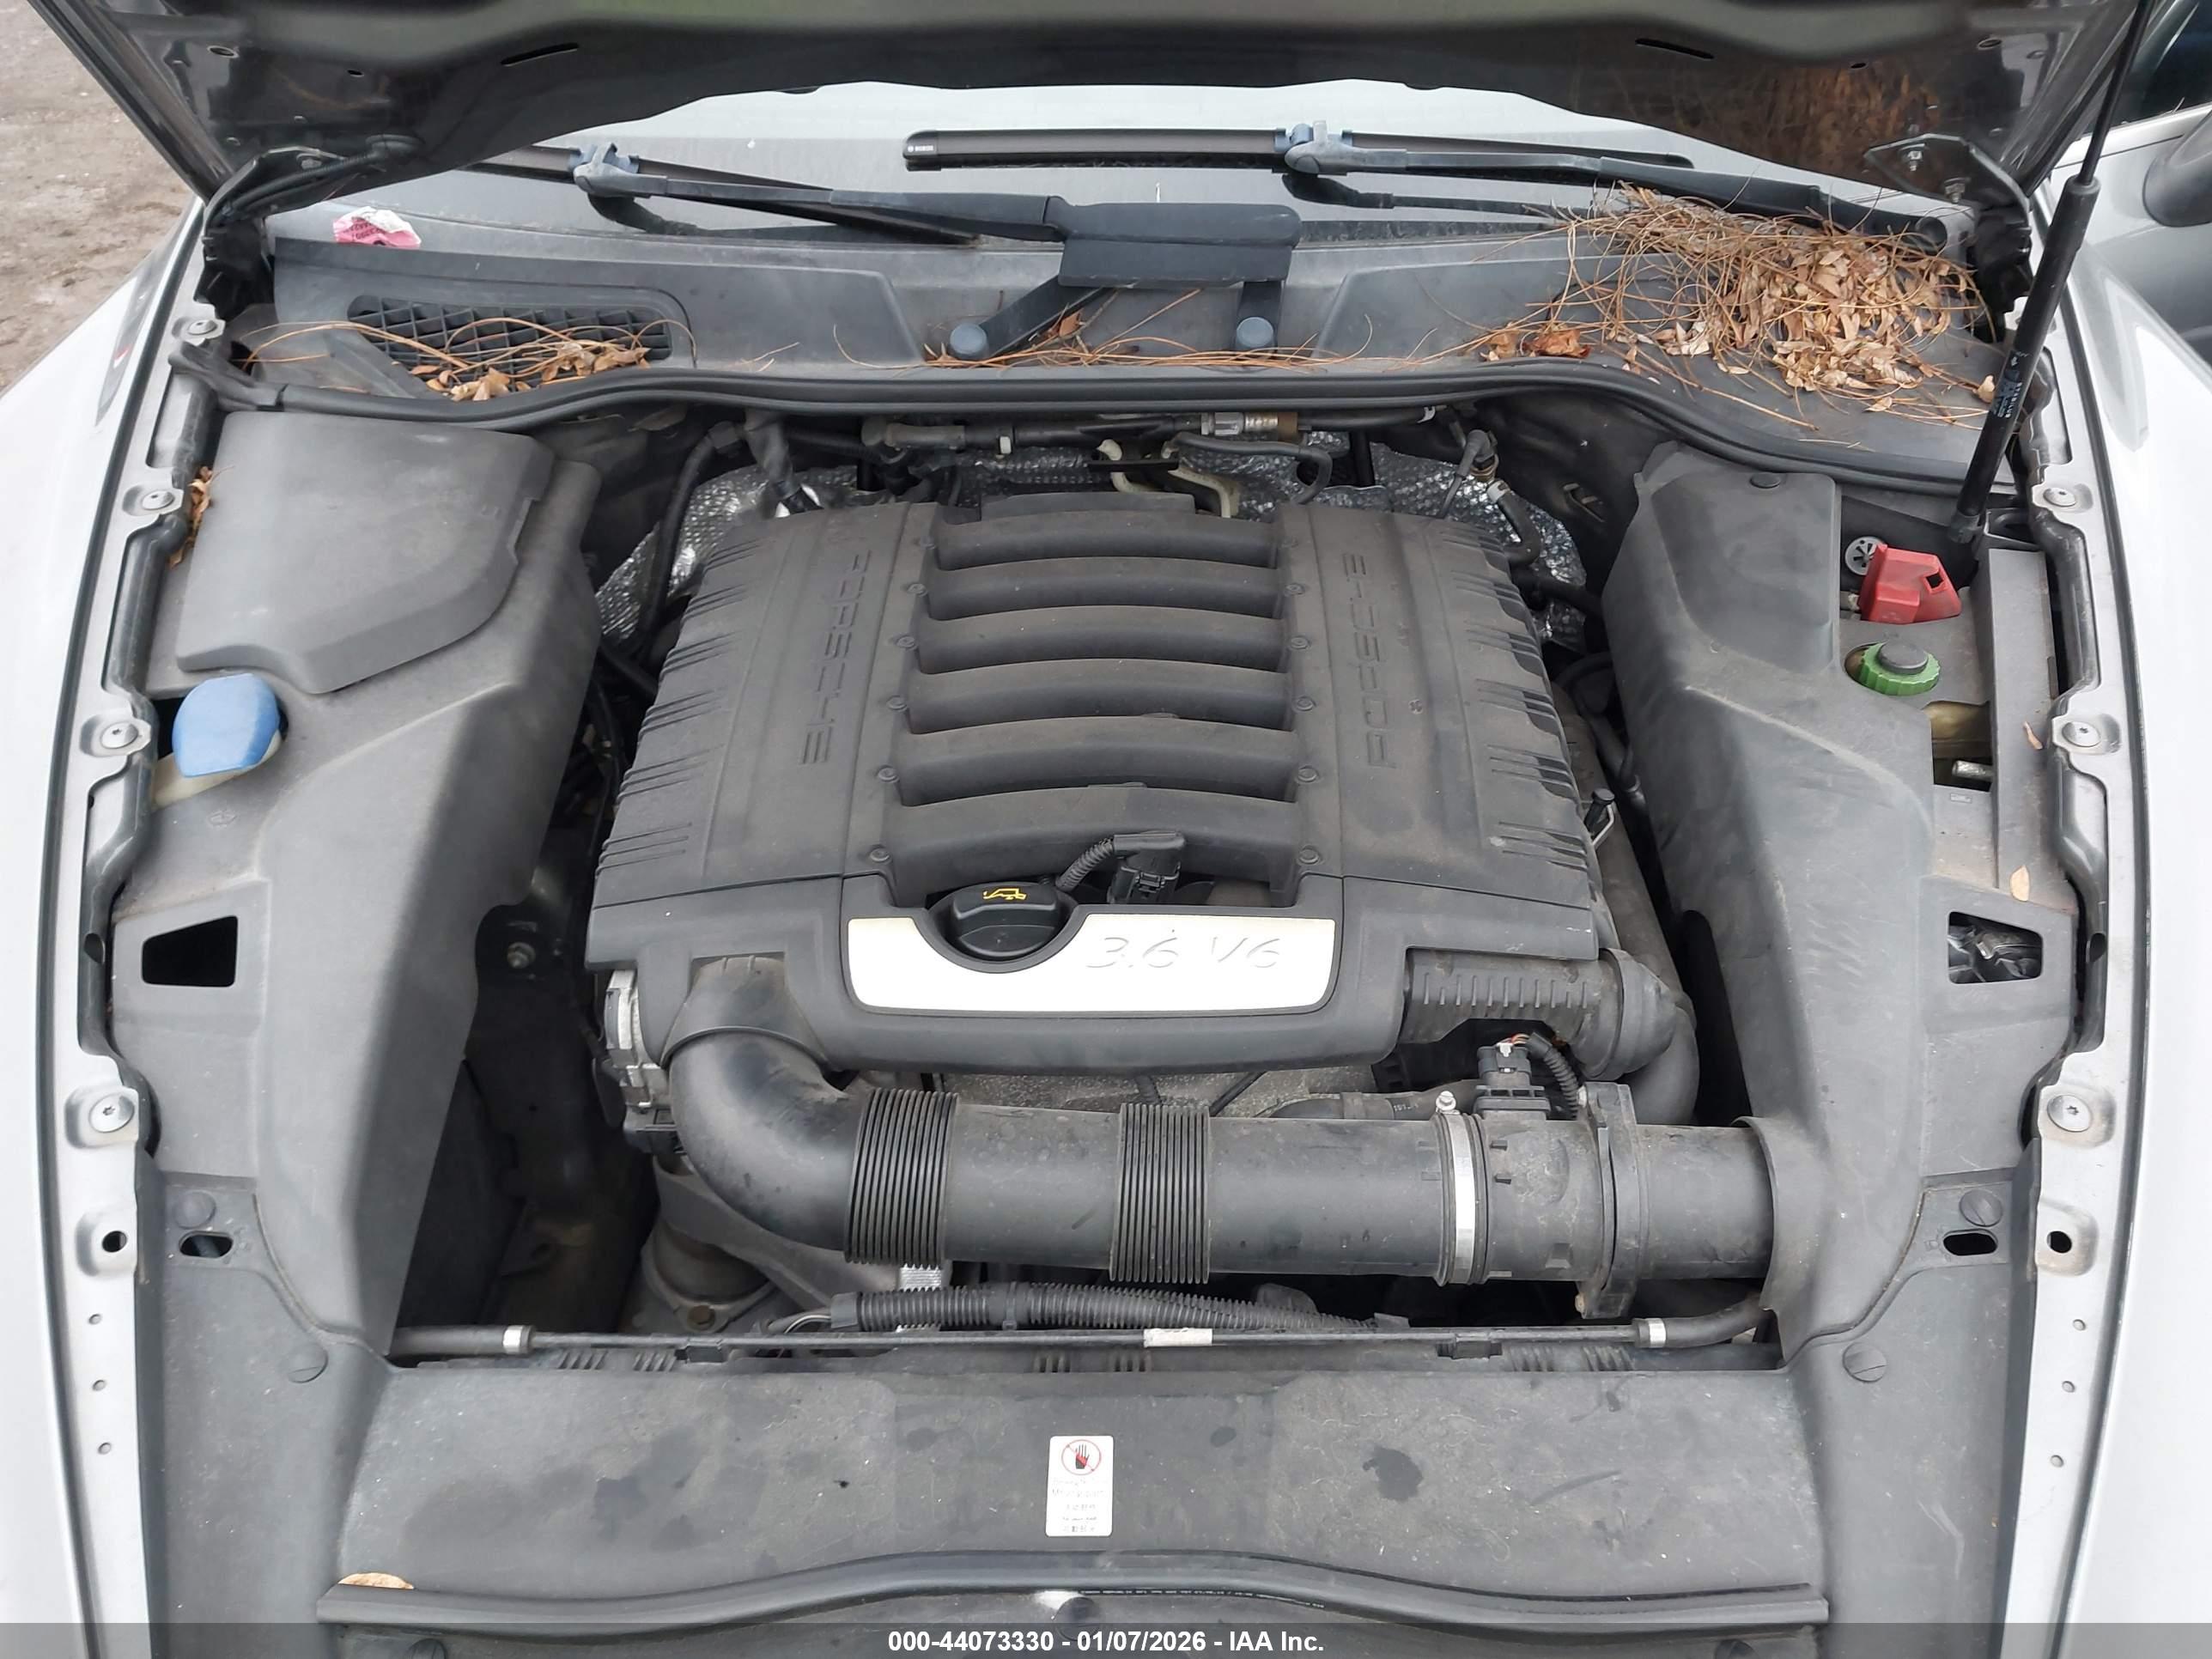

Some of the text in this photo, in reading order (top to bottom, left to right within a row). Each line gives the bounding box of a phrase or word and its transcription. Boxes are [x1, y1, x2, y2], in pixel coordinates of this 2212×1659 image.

[799, 550, 872, 765] PORSCHE
[1340, 552, 1397, 769] PORSCHE
[1085, 937, 1280, 969] 3.6 V6
